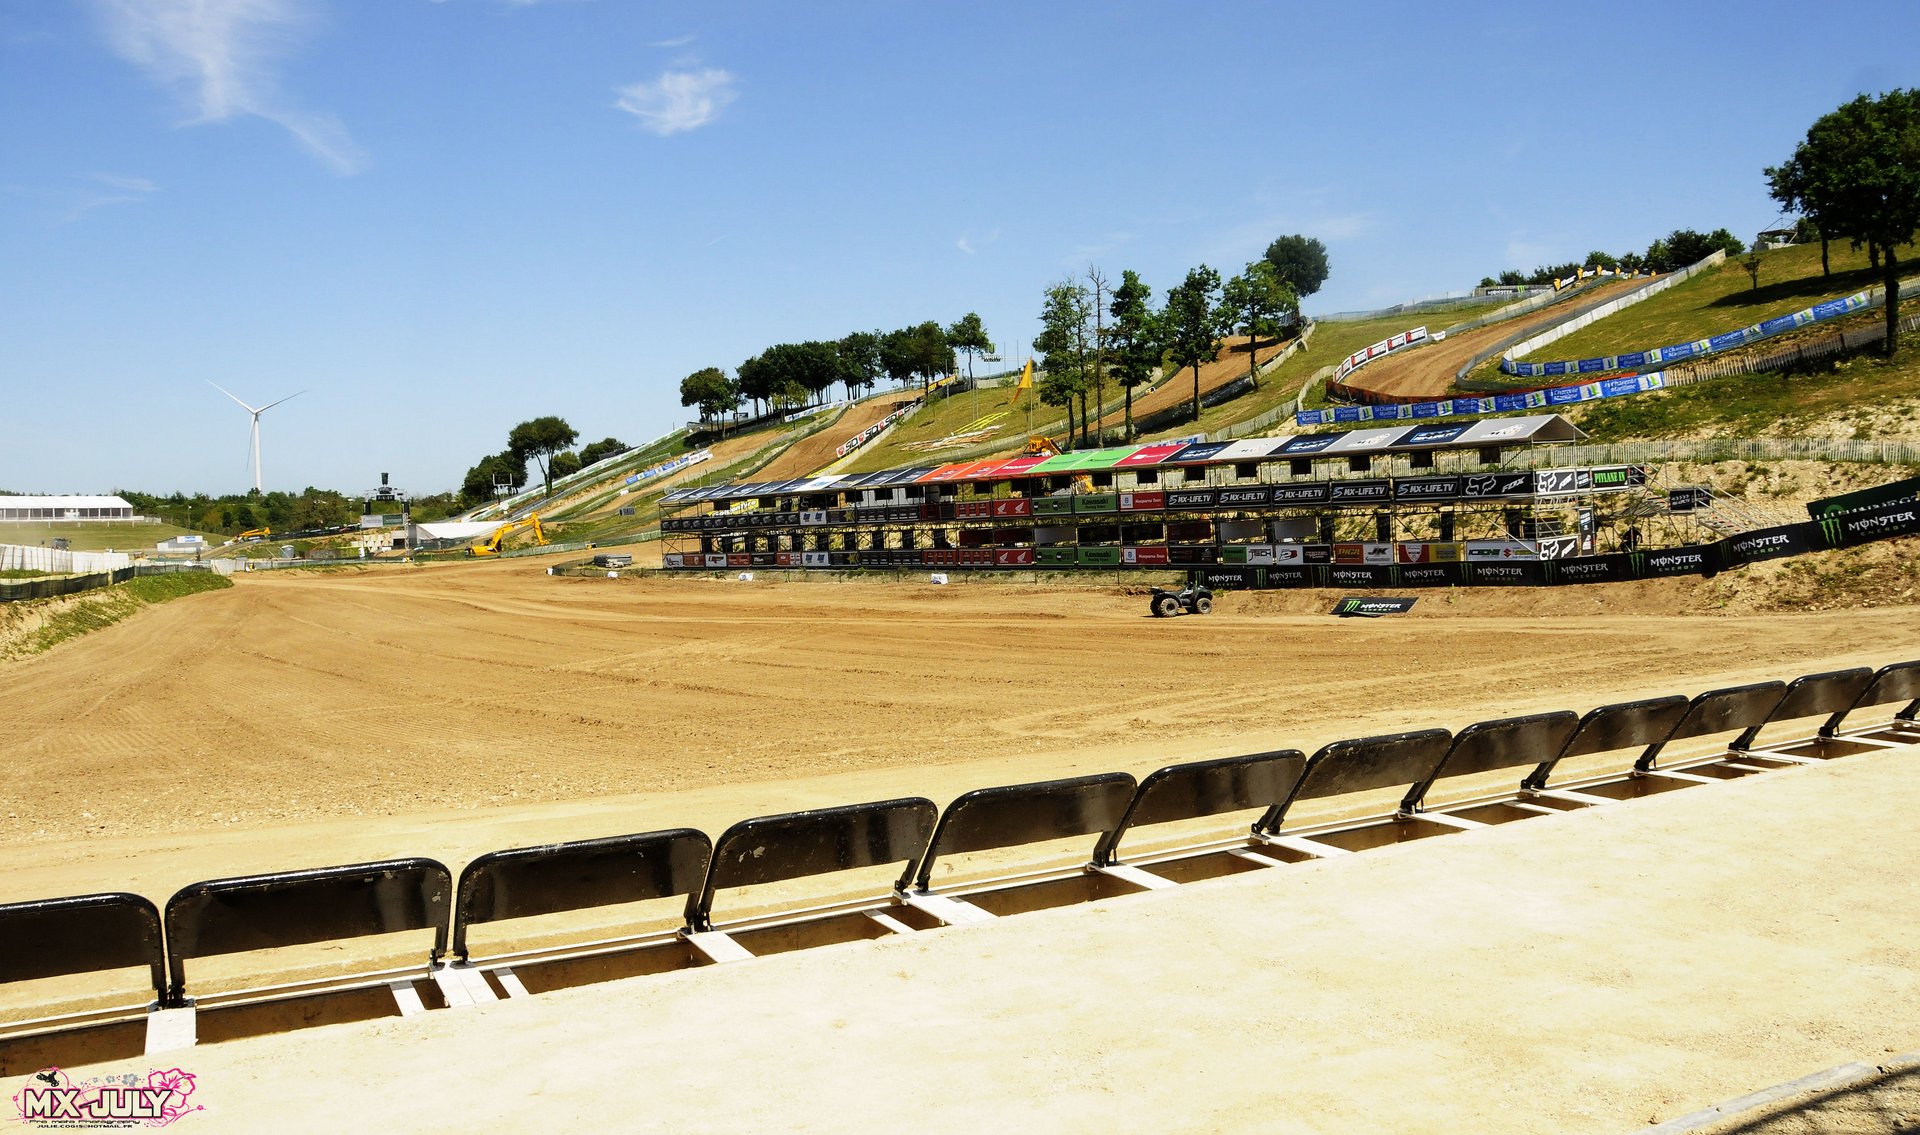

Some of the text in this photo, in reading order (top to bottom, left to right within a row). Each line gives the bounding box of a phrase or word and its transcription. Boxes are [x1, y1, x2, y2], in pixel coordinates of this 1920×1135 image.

[1594, 472, 1618, 483] PITLANE
[1618, 472, 1626, 481] IN
[1502, 477, 1525, 493] FOX
[1848, 511, 1916, 531] MONSTER
[1733, 534, 1790, 551] MONSTER
[1650, 554, 1702, 567] MONSTER
[1405, 569, 1445, 578] MONSTER
[1477, 567, 1523, 576] MONSTER
[1561, 563, 1608, 574] MONSTER
[1208, 574, 1242, 582] MONSTER
[1269, 571, 1302, 579] MONSTER
[1333, 570, 1372, 579] MONSTER
